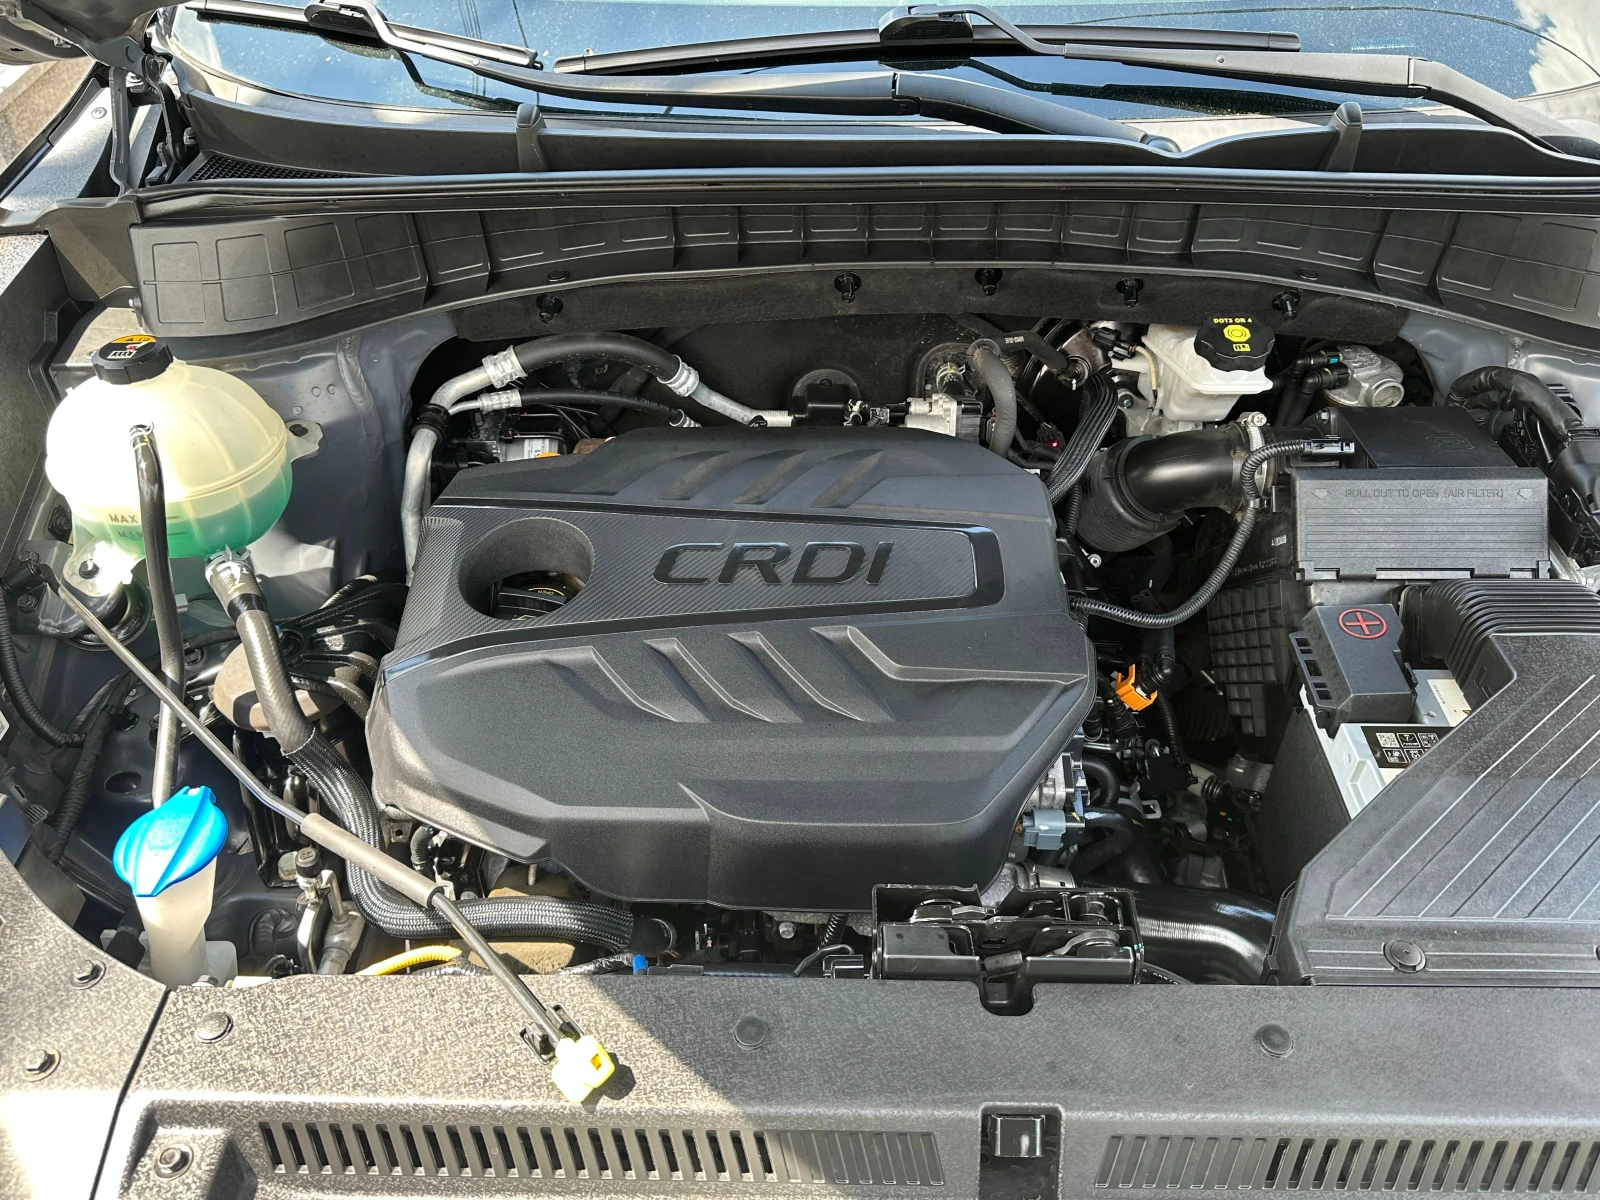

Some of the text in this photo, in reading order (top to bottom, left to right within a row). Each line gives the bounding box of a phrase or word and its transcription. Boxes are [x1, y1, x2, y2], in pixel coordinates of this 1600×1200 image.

[1345, 488, 1371, 498] PULL
[1373, 488, 1395, 498] OUT
[1396, 488, 1409, 498] TO
[1412, 488, 1439, 498] OPEN
[108, 513, 139, 524] MAX
[652, 541, 895, 585] CRDI
